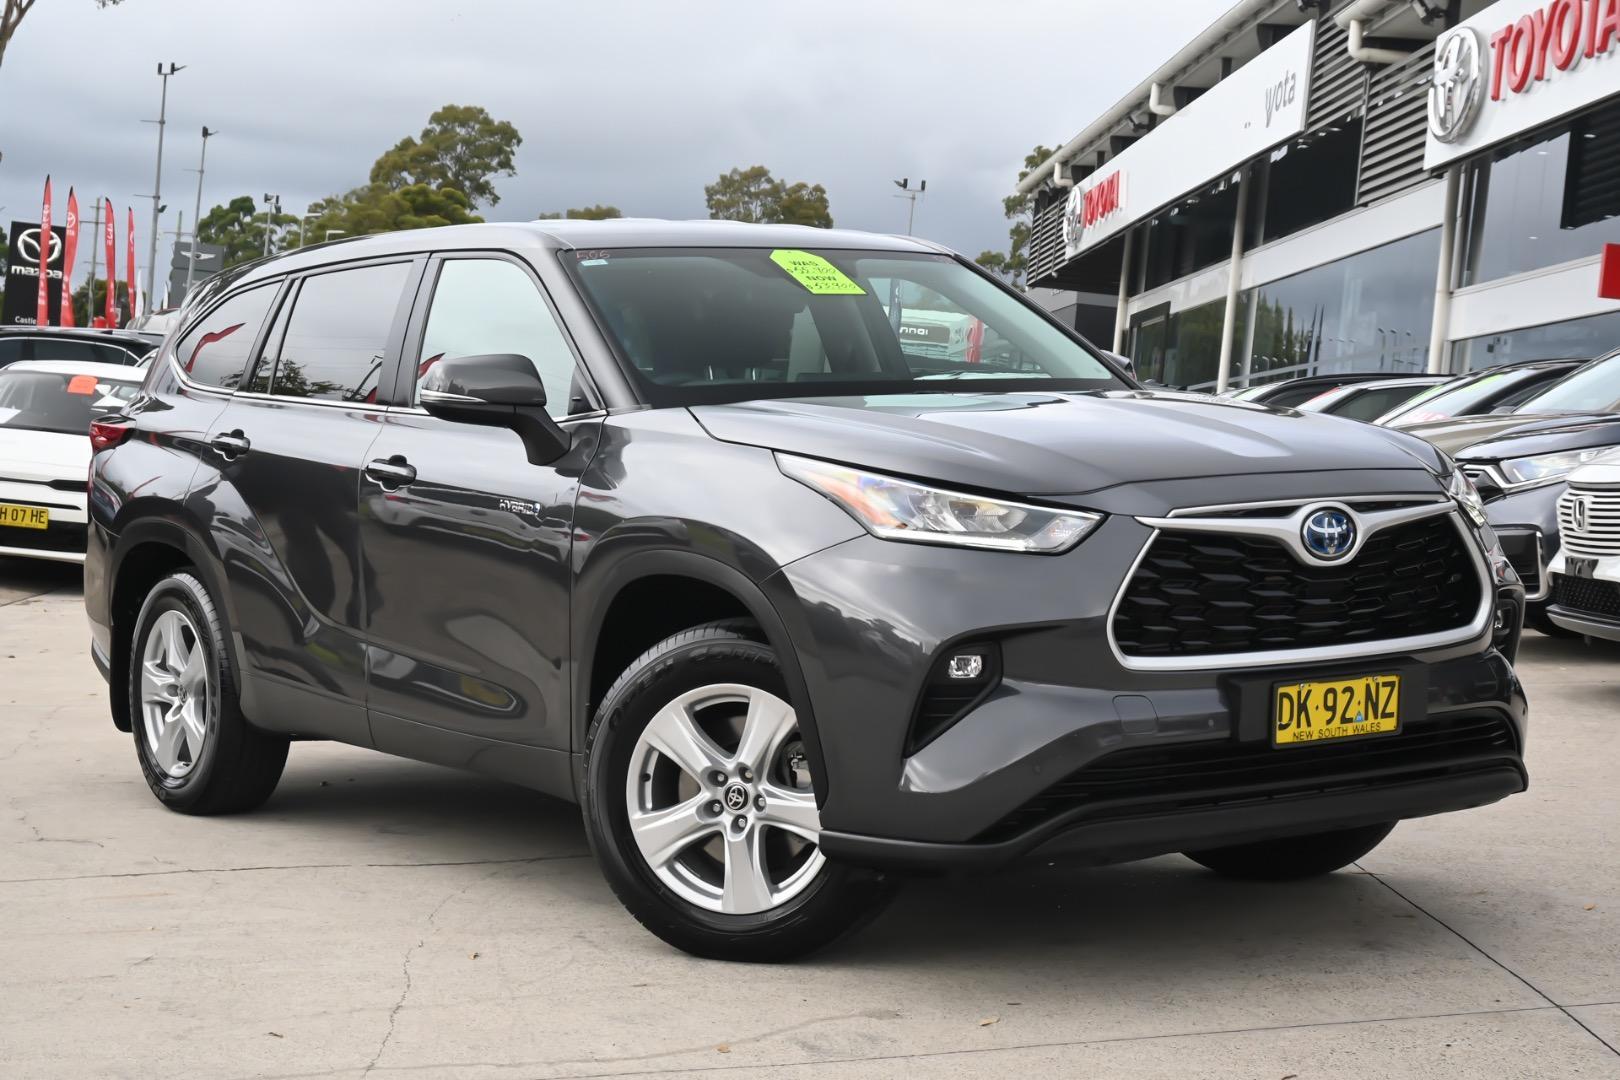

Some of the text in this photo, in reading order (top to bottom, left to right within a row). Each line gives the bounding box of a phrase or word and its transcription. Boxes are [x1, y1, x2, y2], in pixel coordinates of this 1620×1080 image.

[1490, 0, 1620, 101] TOYOTA
[30, 509, 47, 524] HE
[1293, 721, 1381, 741] NEW SOUTH WALES
